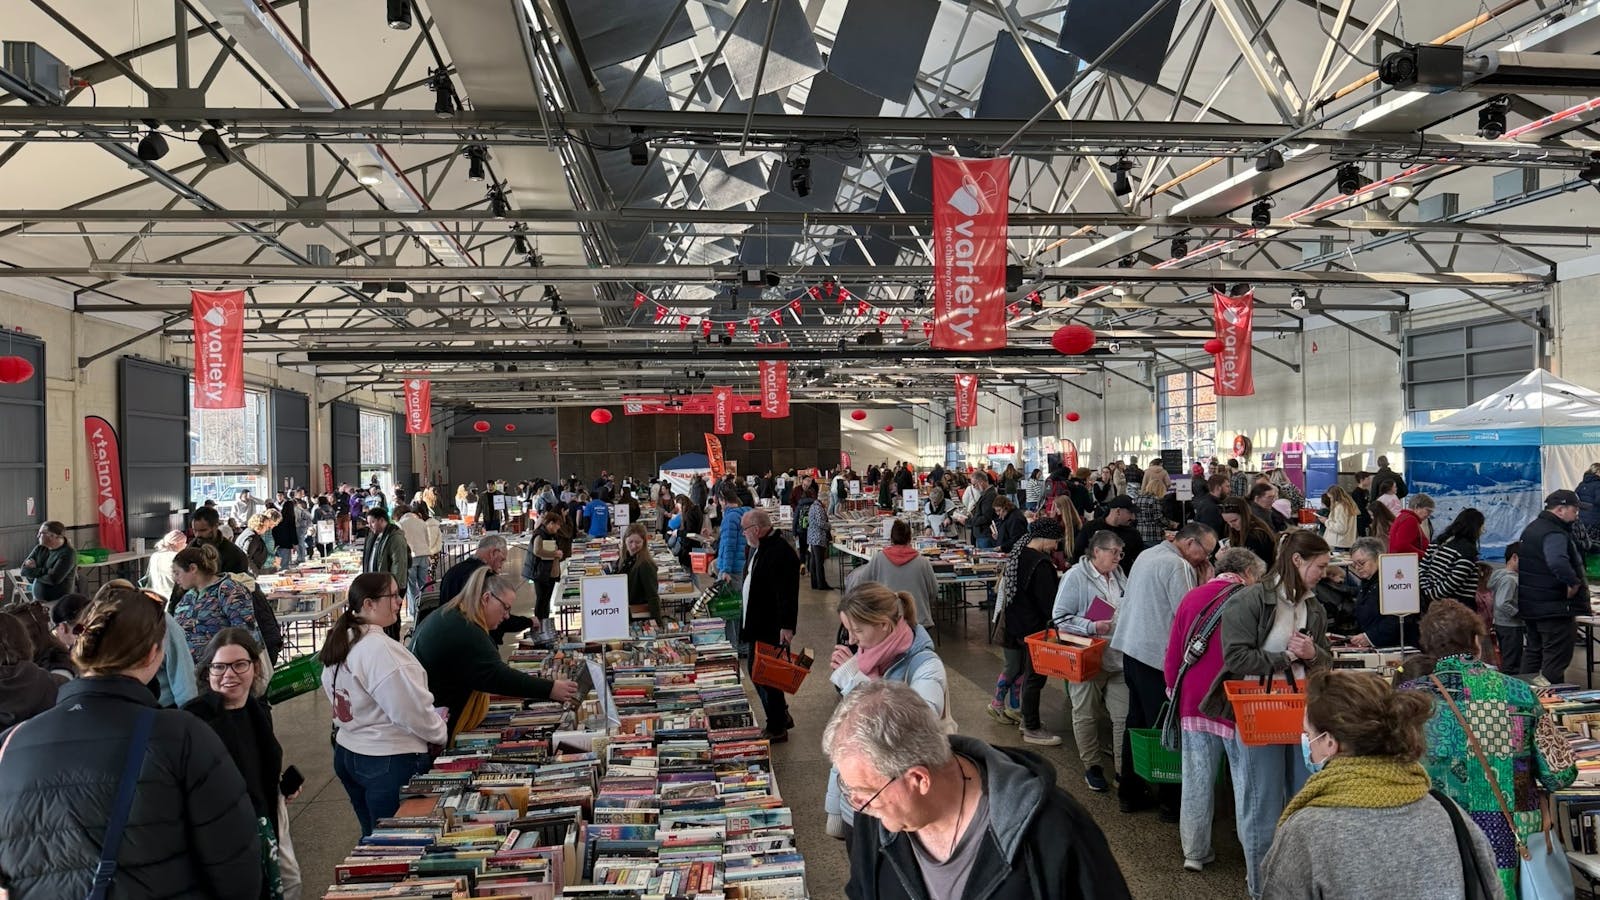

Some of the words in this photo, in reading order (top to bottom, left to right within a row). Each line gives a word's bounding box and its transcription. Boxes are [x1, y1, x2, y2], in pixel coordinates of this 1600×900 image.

[946, 227, 954, 241] the
[950, 219, 980, 339] variety
[206, 328, 227, 402] variety
[1223, 326, 1239, 390] variety
[411, 391, 423, 430] variety
[767, 366, 780, 414] variety
[717, 401, 728, 431] variety
